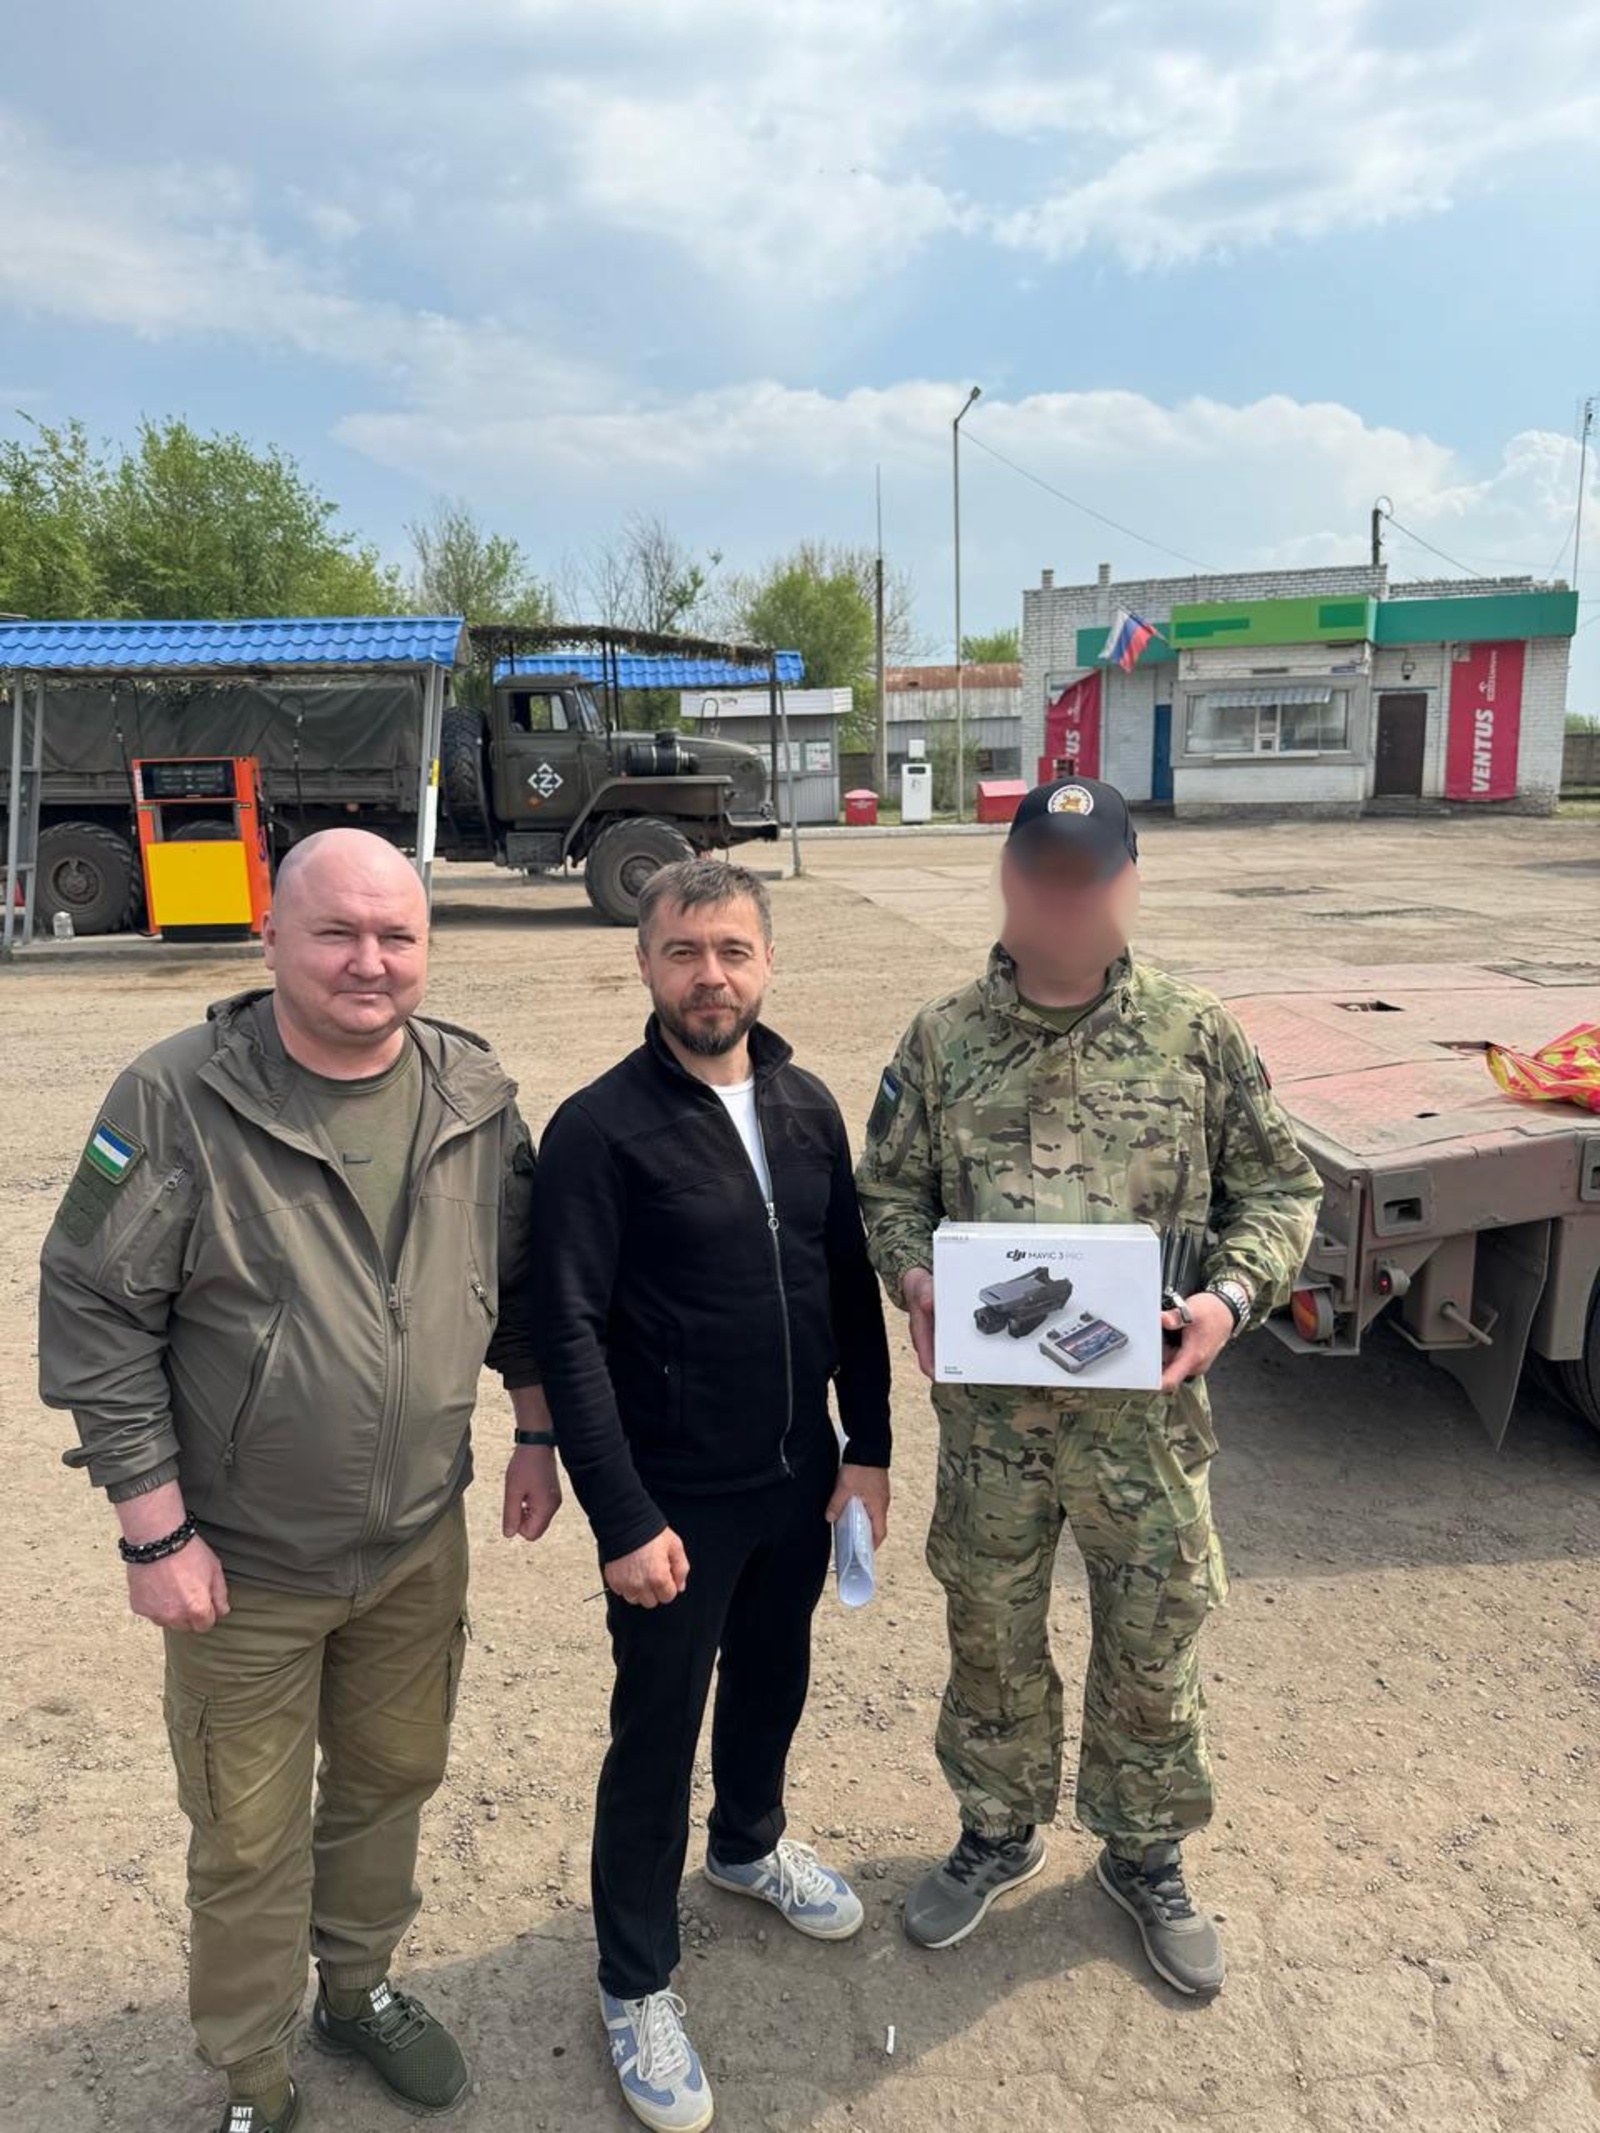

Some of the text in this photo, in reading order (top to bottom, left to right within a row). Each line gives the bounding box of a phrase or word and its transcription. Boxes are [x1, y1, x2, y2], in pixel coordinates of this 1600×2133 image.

[1471, 710, 1494, 793] VENTUS
[539, 773, 553, 788] Z
[1058, 1252, 1064, 1260] 3
